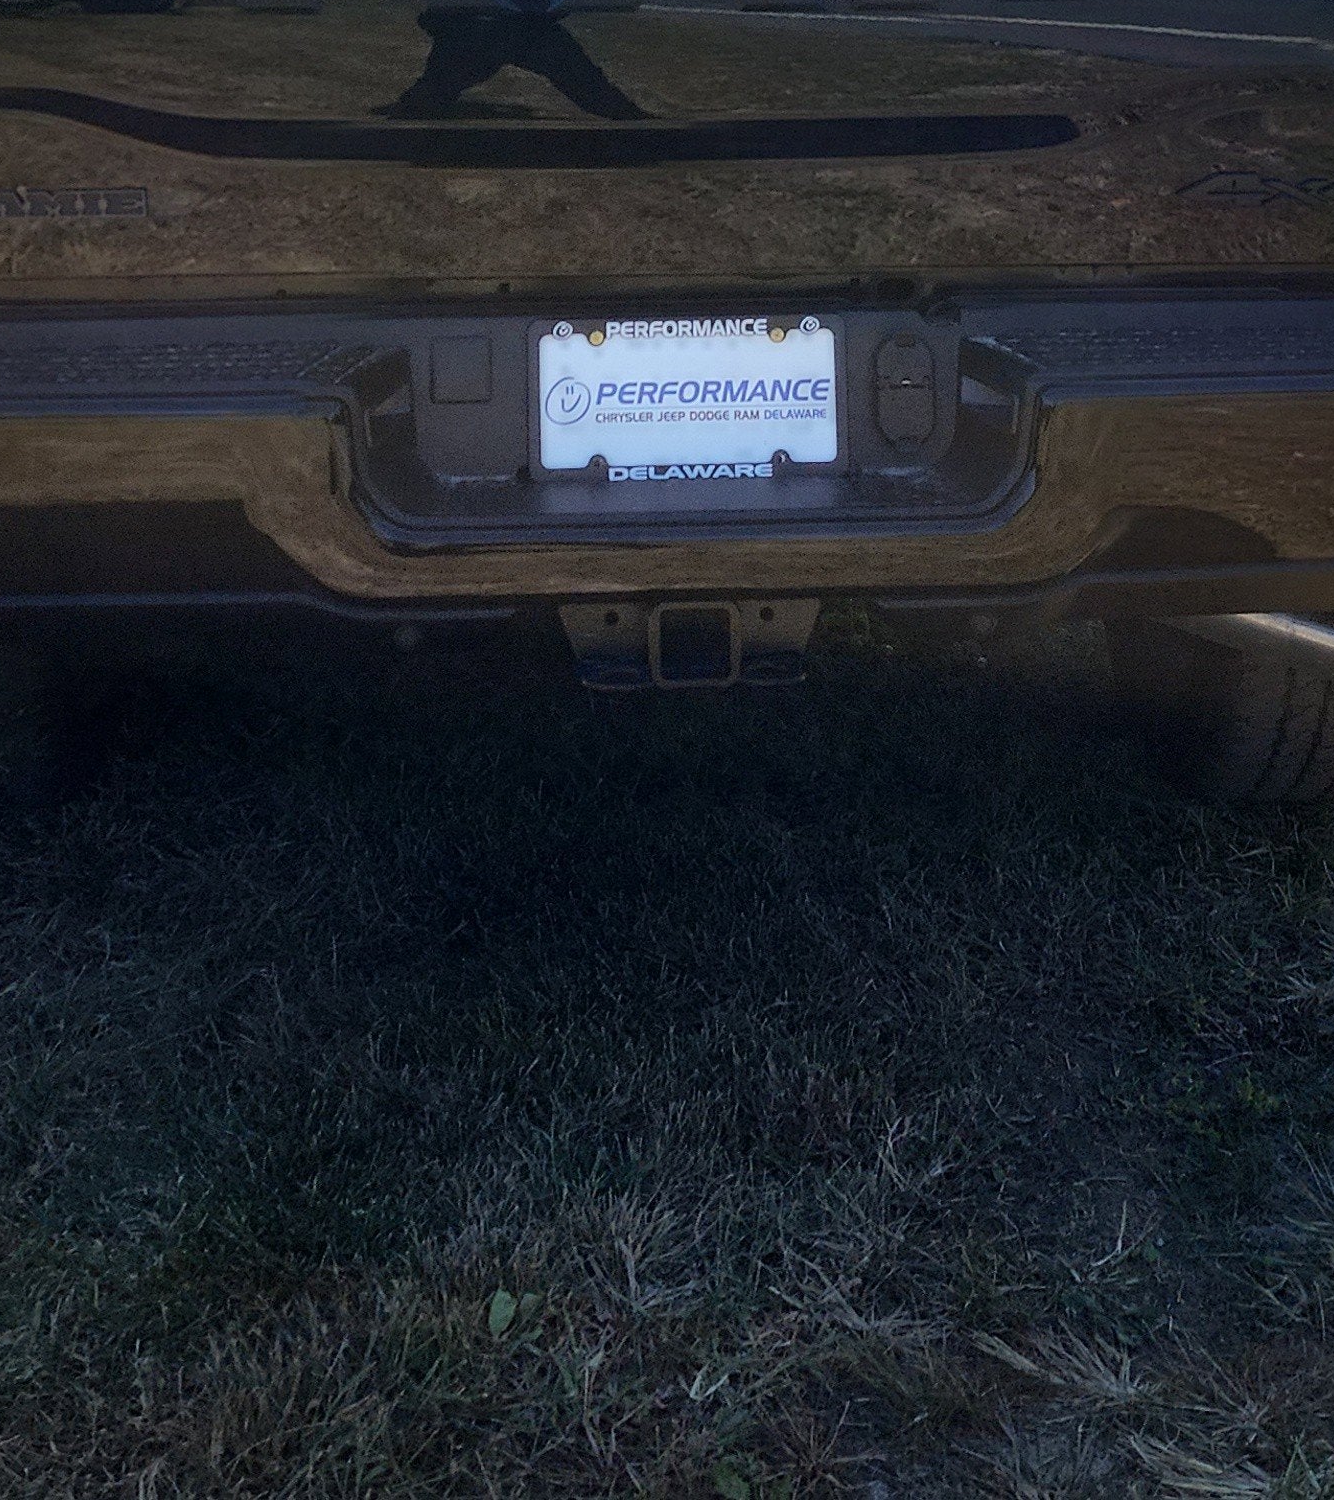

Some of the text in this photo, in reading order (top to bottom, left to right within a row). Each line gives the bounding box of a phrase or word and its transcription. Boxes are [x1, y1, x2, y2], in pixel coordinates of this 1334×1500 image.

[605, 318, 768, 339] PERFORMANCE
[595, 378, 831, 406] PERFORMANCE
[595, 408, 827, 424] CHRYSLER JEEP DODGE RAM DELAWARE
[608, 463, 774, 482] DELAWARE
